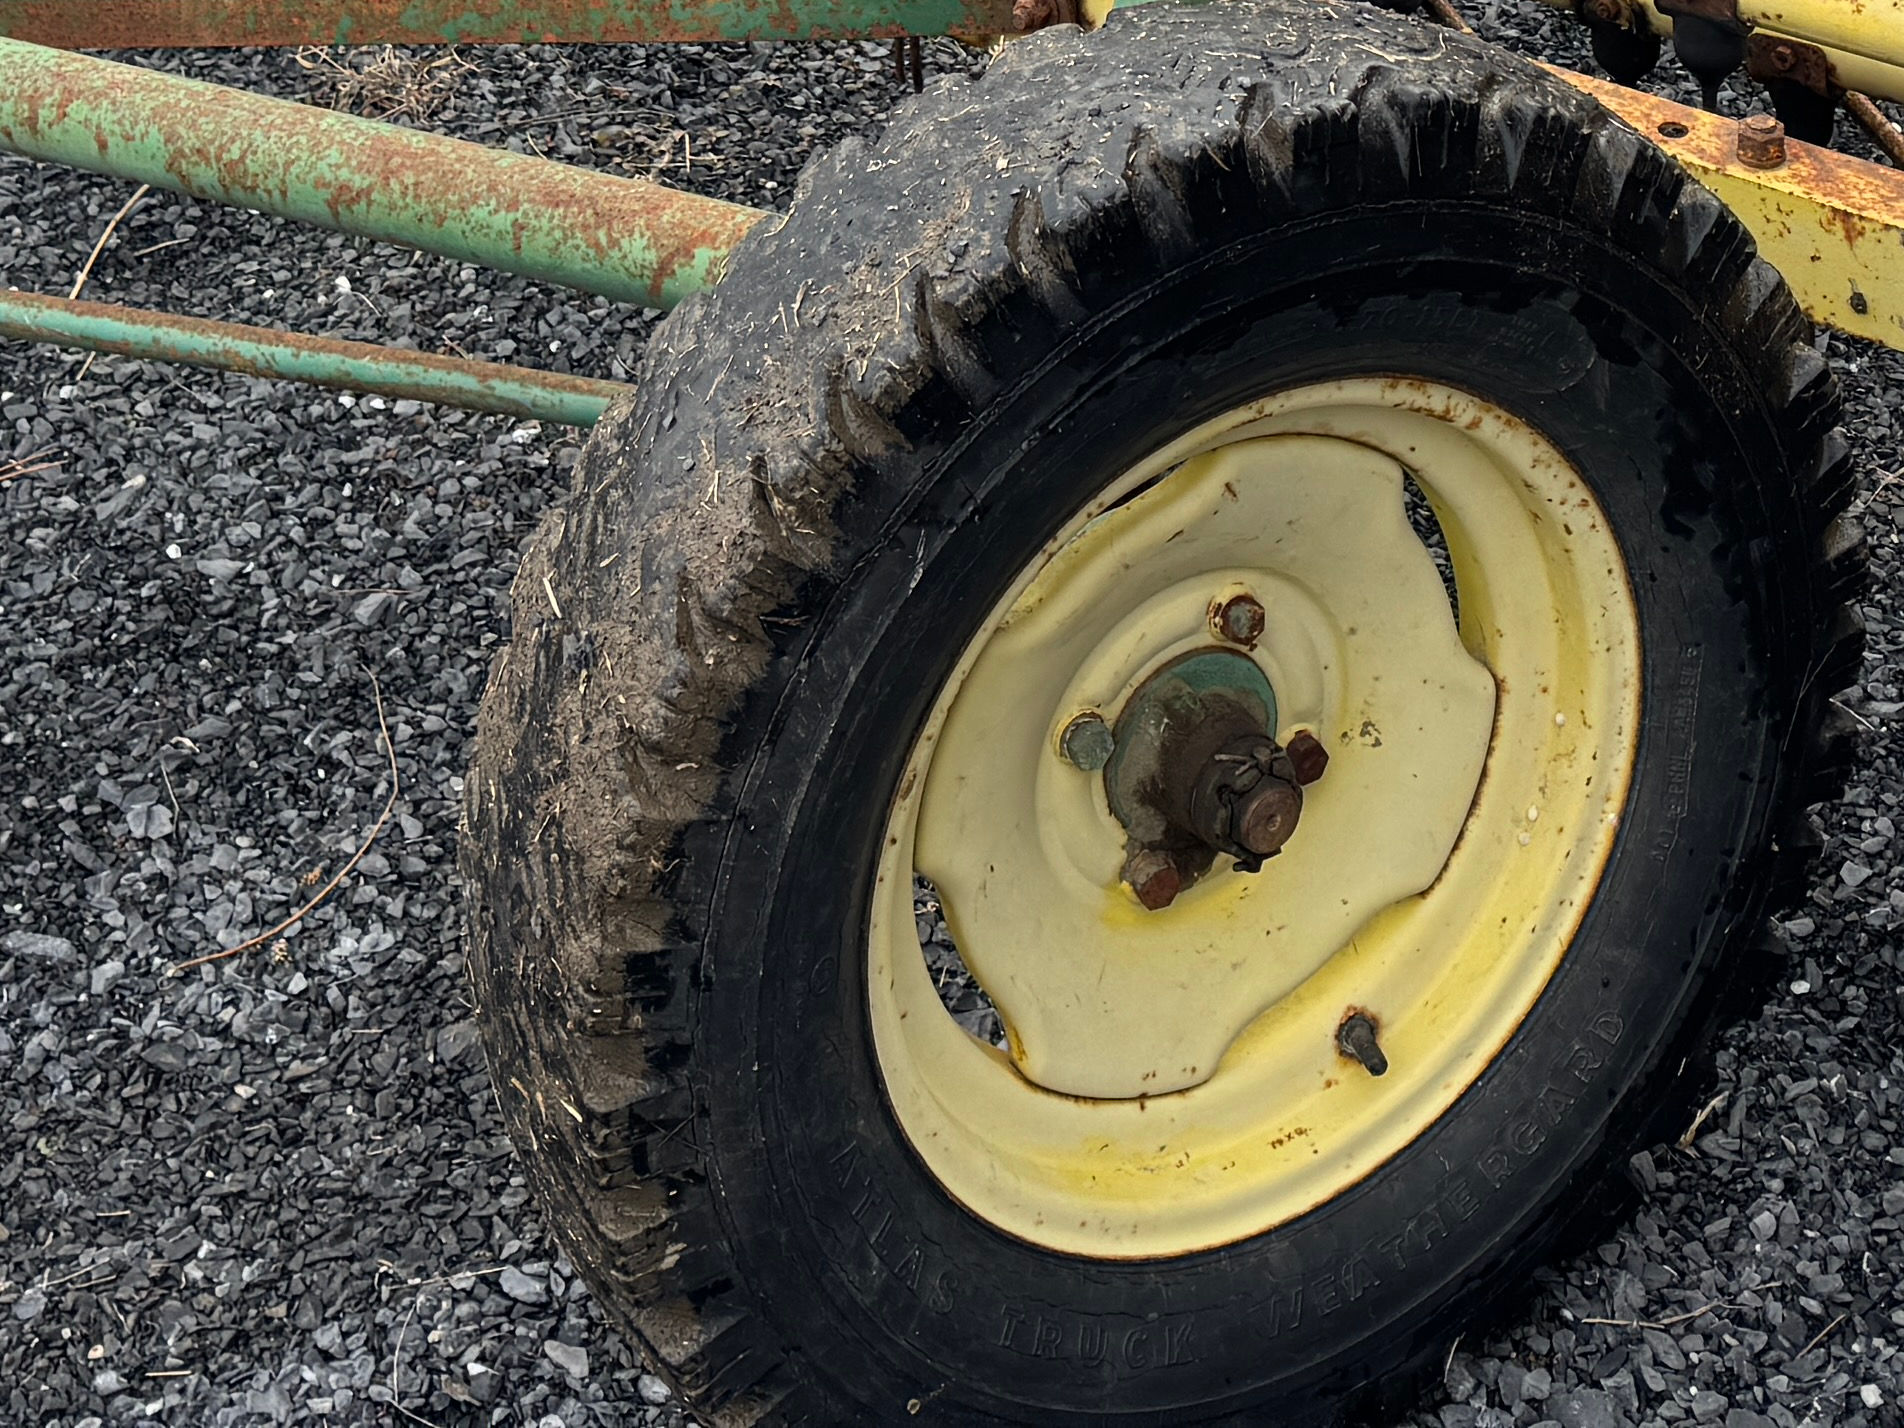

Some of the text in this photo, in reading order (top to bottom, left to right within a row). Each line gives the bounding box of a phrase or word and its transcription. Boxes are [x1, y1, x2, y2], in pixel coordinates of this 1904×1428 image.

[829, 1008, 1627, 1371] ATLAS TRUCK WEATHERGARD
